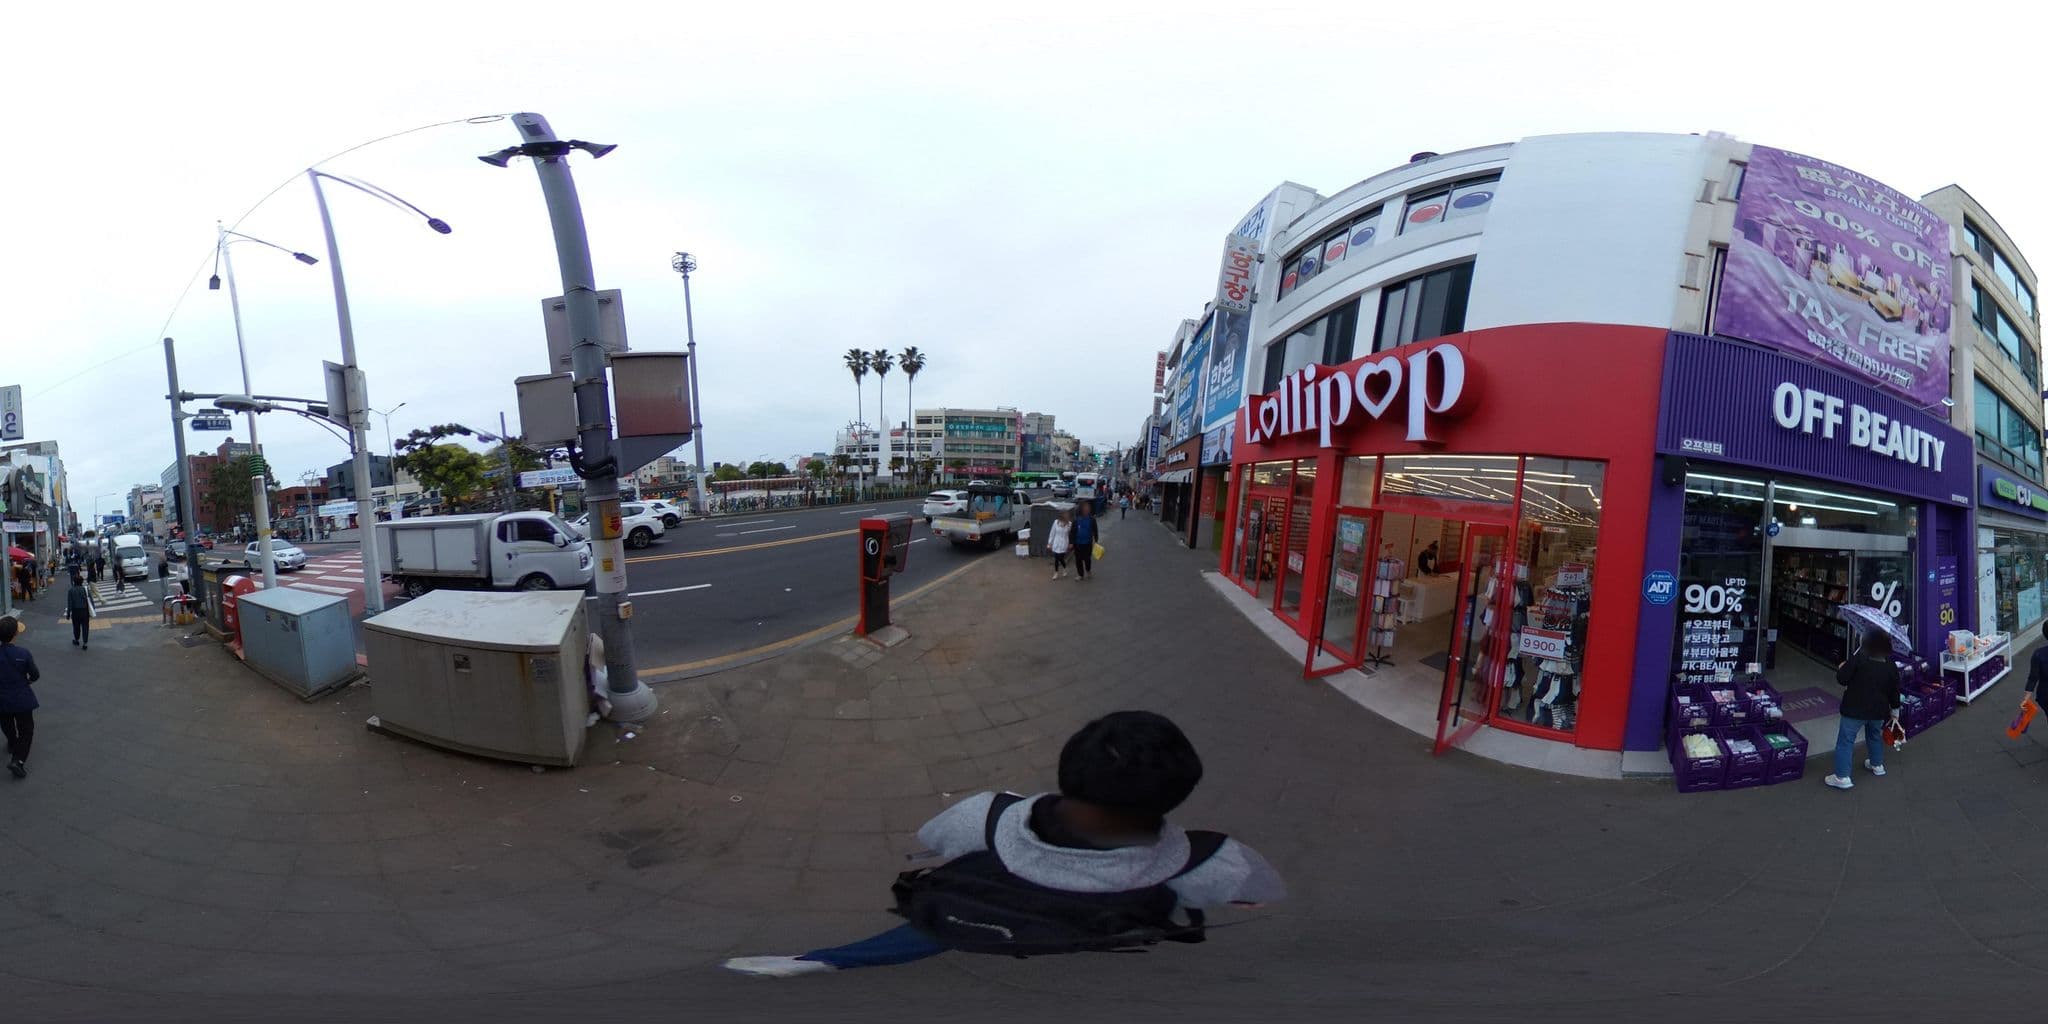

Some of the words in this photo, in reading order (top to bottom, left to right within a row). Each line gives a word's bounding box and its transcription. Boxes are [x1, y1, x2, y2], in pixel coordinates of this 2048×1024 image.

[1824, 187, 1882, 216] GRAND
[1891, 242, 1946, 280] OFF
[1783, 285, 1850, 340] TAX
[1858, 324, 1932, 372] FREE
[4, 412, 17, 433] CU
[1773, 382, 1844, 440] OFF
[1848, 403, 1946, 473] BEAUTY
[1682, 439, 1723, 455] 오프뷰티
[2016, 485, 2031, 507] CU
[1648, 581, 1672, 594] ADT
[1725, 578, 1735, 586] UP
[1735, 578, 1746, 586] TO
[1686, 620, 1731, 631] #오프뷰티
[1940, 608, 1954, 626] 90
[1684, 634, 1730, 644] #보라창고
[1683, 648, 1739, 658] #뷰티아울렛
[1681, 661, 1737, 671] #K-BEAUTY
